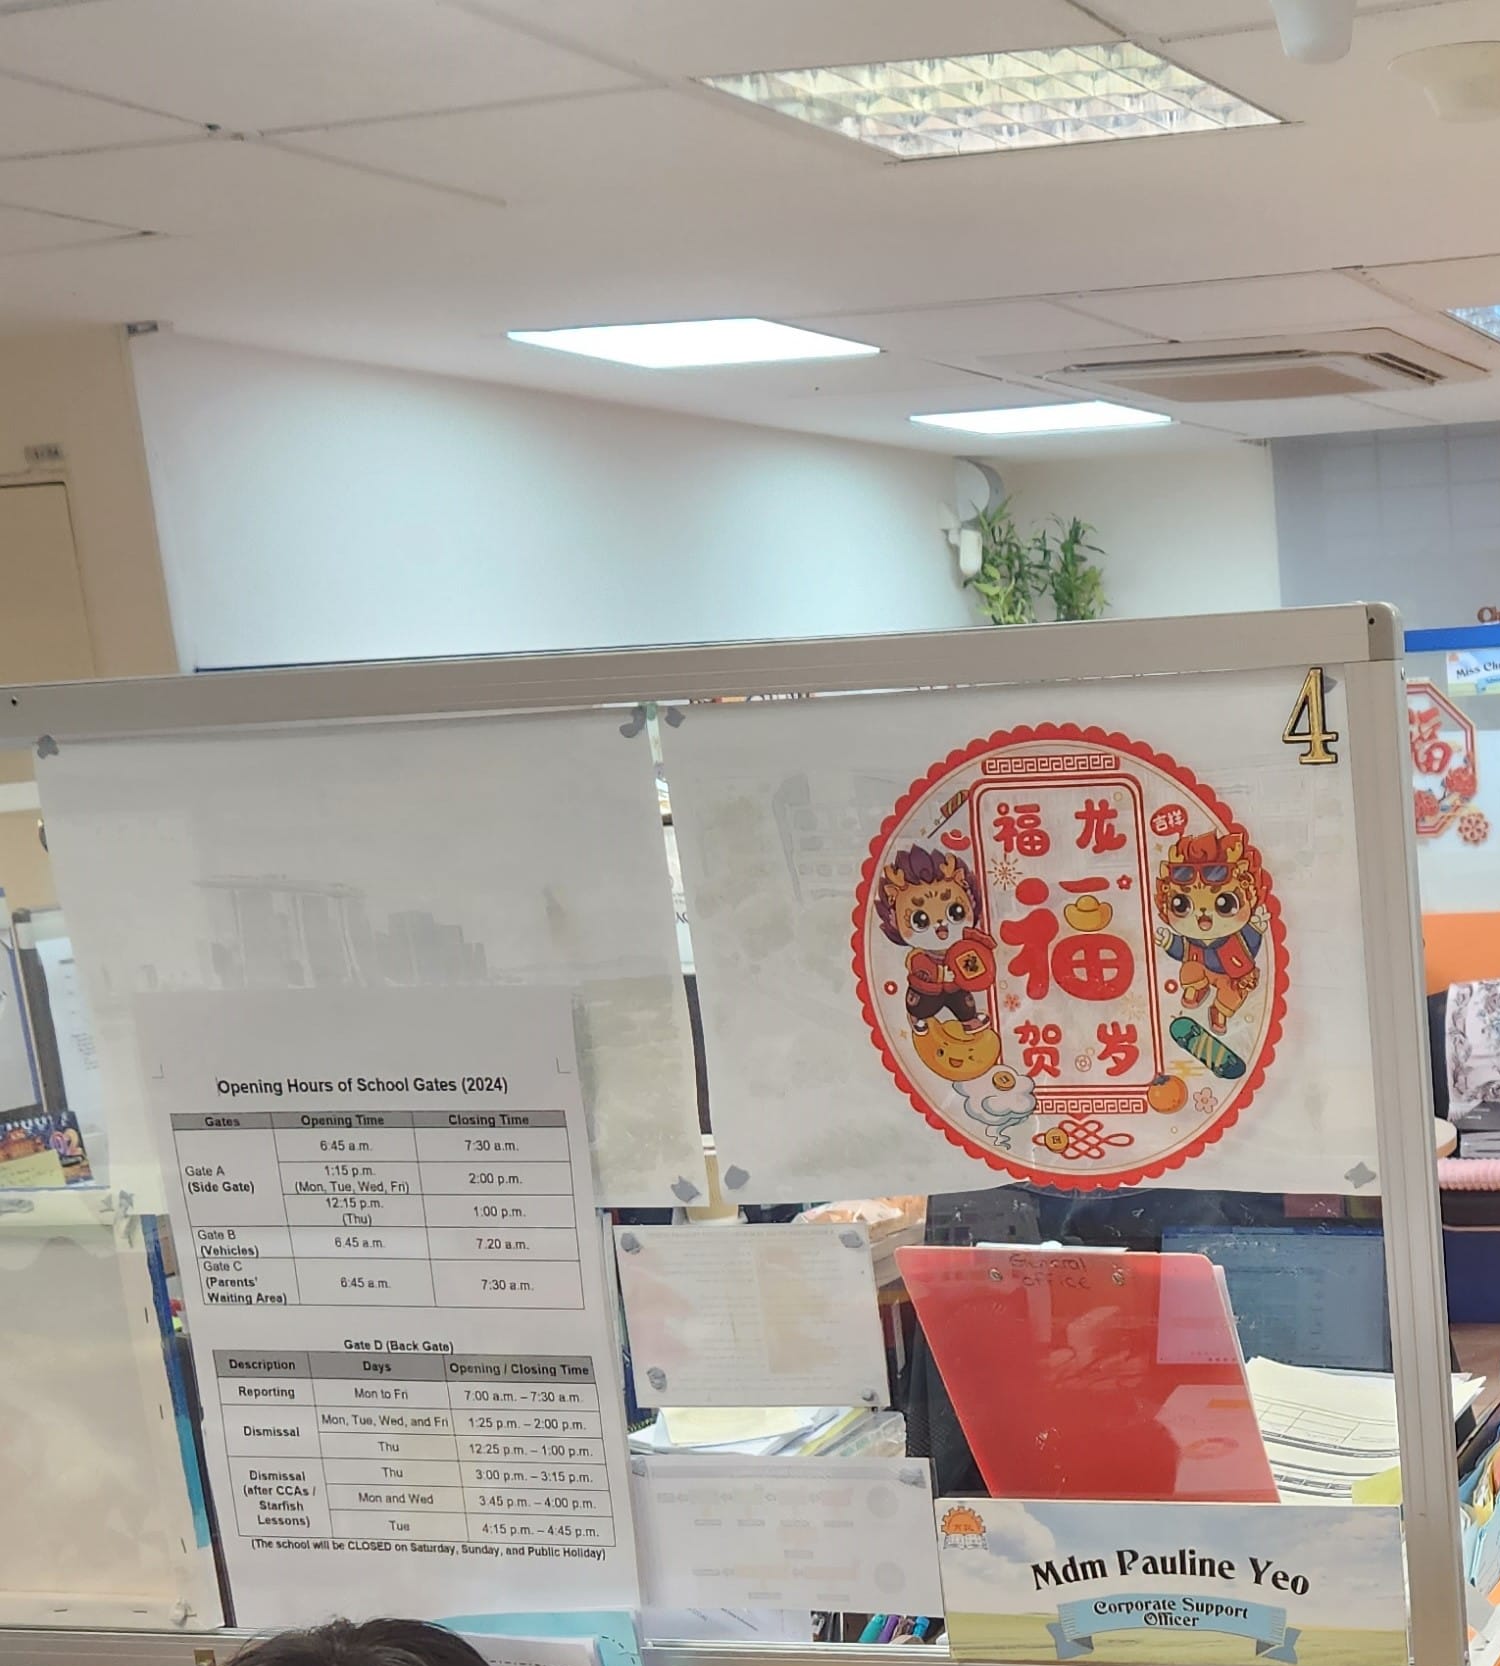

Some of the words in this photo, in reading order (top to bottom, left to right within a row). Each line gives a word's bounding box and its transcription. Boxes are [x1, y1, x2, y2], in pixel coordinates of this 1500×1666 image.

[1456, 667, 1480, 679] Miss
[1282, 666, 1339, 765] 4
[218, 1079, 283, 1097] Opening
[287, 1078, 333, 1093] Hours
[338, 1078, 352, 1092] of
[356, 1077, 408, 1092] School
[414, 1077, 457, 1091] Gates
[462, 1077, 508, 1094] (2024)
[205, 1117, 240, 1127] Gates
[301, 1115, 351, 1127] Opening
[355, 1115, 384, 1125] Time
[449, 1115, 495, 1127] Closing
[500, 1115, 529, 1125] Time
[185, 1166, 212, 1176] Gate
[216, 1166, 225, 1176] A
[469, 1173, 493, 1184] 2:00
[188, 1182, 220, 1194] (Side
[223, 1182, 255, 1194] Gate)
[391, 1181, 409, 1193] Fri)
[342, 1214, 372, 1226] (Thu)
[197, 1230, 225, 1240] Gate
[228, 1230, 236, 1239] B
[200, 1246, 259, 1258] (Vehicles)
[203, 1261, 231, 1271] Gate
[233, 1261, 243, 1271] C
[206, 1277, 258, 1289] (Parents'
[481, 1279, 506, 1290] 7:30
[208, 1292, 252, 1305] Waiting
[256, 1293, 287, 1305] Area)
[344, 1340, 371, 1350] Gate
[374, 1341, 383, 1350] D
[386, 1340, 419, 1352] (Back
[422, 1341, 454, 1354] Gate)
[229, 1359, 296, 1370] Description
[362, 1361, 392, 1373] Days
[450, 1363, 501, 1376] Opening
[511, 1364, 557, 1376] Closing
[560, 1364, 589, 1375] Time
[238, 1386, 295, 1399] Reporting
[354, 1388, 378, 1399] Mon
[380, 1388, 391, 1399] to
[394, 1389, 408, 1399] Fri
[530, 1391, 555, 1402] 7:30
[321, 1415, 349, 1426] Mon,
[352, 1415, 376, 1426] Tue,
[379, 1416, 408, 1428] Wed,
[410, 1417, 431, 1427] and
[434, 1417, 449, 1427] Fri
[534, 1419, 559, 1430] 2:00
[243, 1426, 300, 1437] Dismissal
[378, 1441, 399, 1452] Thu
[249, 1470, 306, 1482] Dismissal
[382, 1467, 403, 1478] Thu
[542, 1472, 565, 1482] 3:15
[243, 1485, 272, 1497] (after
[276, 1485, 309, 1496] CCAs
[358, 1492, 383, 1503] Mon
[385, 1493, 406, 1503] and
[409, 1494, 434, 1504] Wed
[259, 1500, 304, 1512] Starfish
[257, 1515, 310, 1528] Lessons)
[389, 1521, 410, 1531] Tue
[482, 1524, 507, 1534] 4:15
[547, 1526, 571, 1537] 4:45
[251, 1539, 274, 1550] (The
[278, 1539, 310, 1550] school
[313, 1540, 330, 1550] will
[332, 1541, 344, 1551] be
[347, 1541, 392, 1552] CLOSED
[395, 1543, 406, 1553] on
[410, 1543, 459, 1556] Saturday,
[461, 1544, 503, 1557] Sunday,
[506, 1545, 525, 1556] and
[527, 1546, 560, 1557] Public
[563, 1547, 606, 1560] Holiday)
[1030, 1555, 1108, 1591] Mdm
[1116, 1549, 1236, 1580] Pauline
[1248, 1557, 1310, 1596] Yeo
[1094, 1598, 1177, 1615] Corporate
[1182, 1597, 1249, 1620] Support
[1143, 1613, 1200, 1627] Officer
